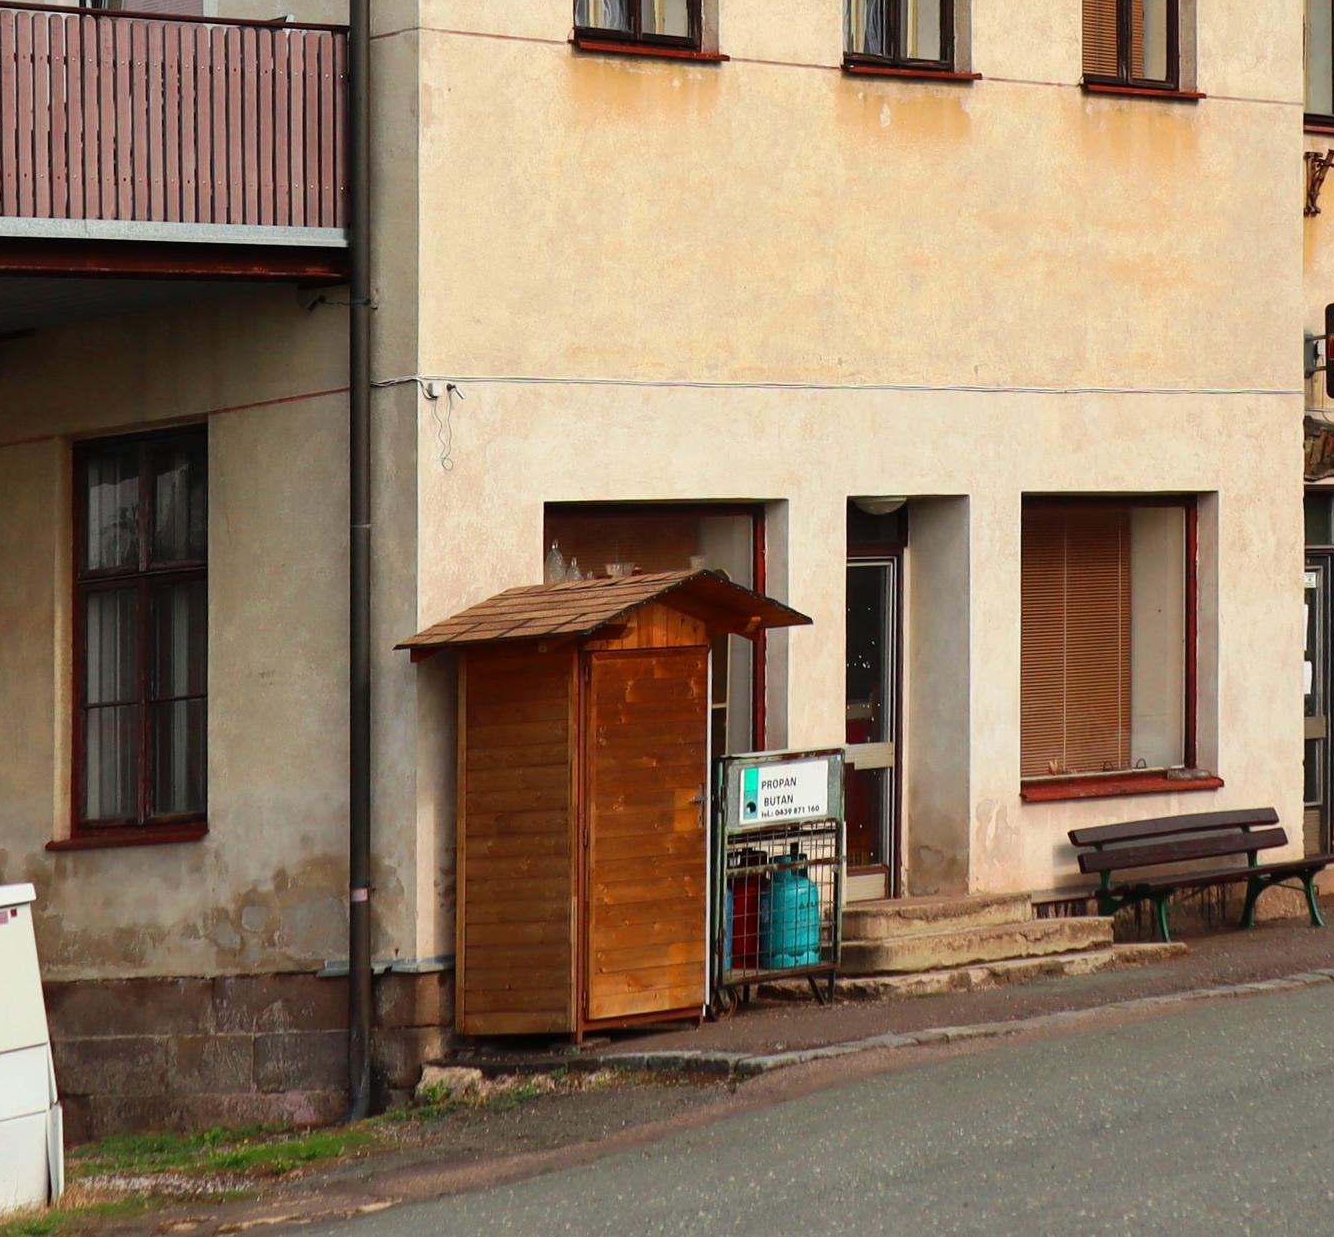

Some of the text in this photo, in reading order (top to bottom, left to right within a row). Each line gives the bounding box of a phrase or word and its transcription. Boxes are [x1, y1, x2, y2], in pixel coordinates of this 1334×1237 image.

[761, 776, 797, 790] PROPAN
[764, 794, 794, 807] BUTAN
[807, 804, 820, 813] 160
